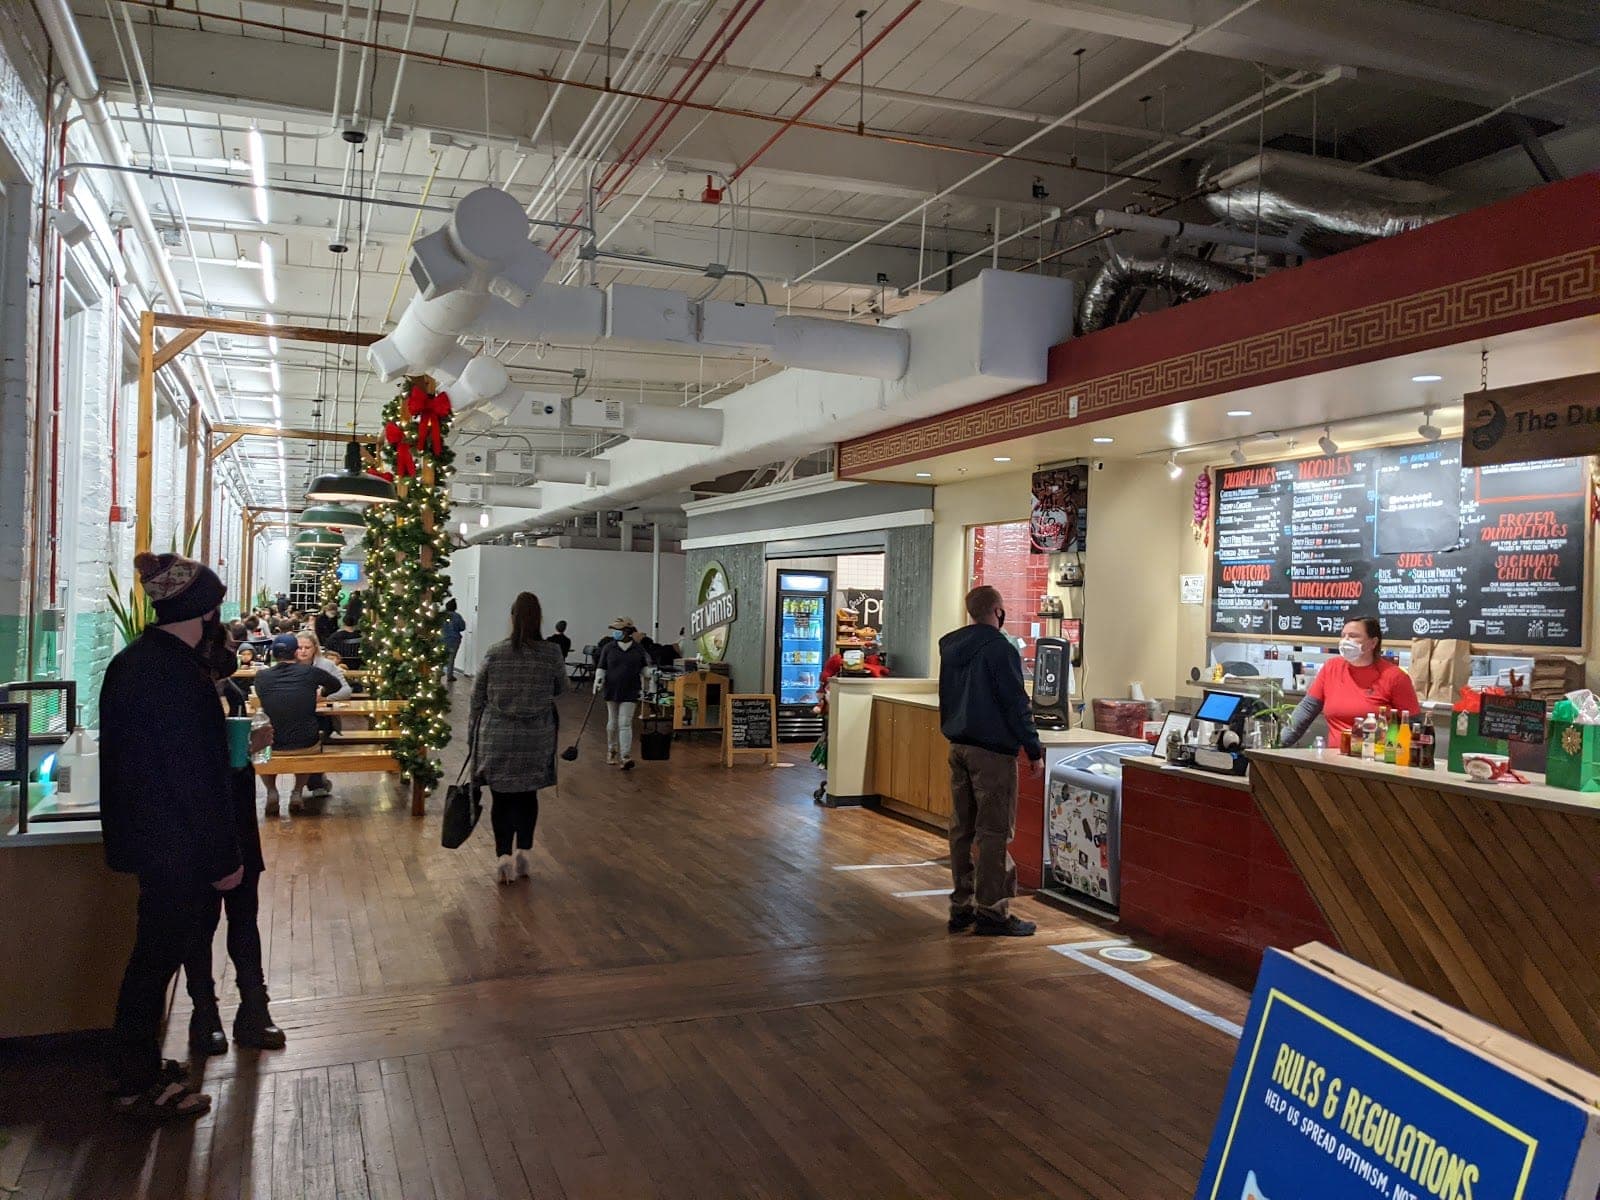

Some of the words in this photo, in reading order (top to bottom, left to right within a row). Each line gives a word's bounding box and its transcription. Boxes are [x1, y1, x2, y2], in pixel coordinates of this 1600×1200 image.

[1514, 408, 1558, 433] The
[1298, 455, 1352, 480] NOODLES
[1223, 467, 1277, 489] DUMPLINGS
[1499, 511, 1558, 527] FROZEN
[1480, 523, 1569, 542] DUMPLINGS
[1397, 553, 1434, 568] SIDES
[1495, 553, 1561, 569] SICHUAN
[1223, 565, 1271, 582] WONTONS
[1306, 565, 1319, 576] TOFU
[1378, 568, 1391, 579] RICE
[1497, 566, 1529, 581] CHILI
[1533, 566, 1557, 580] OIL
[1292, 581, 1324, 599] LUNCH
[1324, 580, 1363, 598] COMBO
[1406, 600, 1422, 611] BELLY
[691, 607, 704, 636] PET
[1264, 1088, 1287, 1115] HELP
[1287, 1105, 1300, 1126] US
[1300, 1117, 1337, 1155] SPREAD
[1272, 1043, 1326, 1108] RULES
[1323, 1078, 1342, 1120] &
[1340, 1087, 1480, 1200] REGULATIONS
